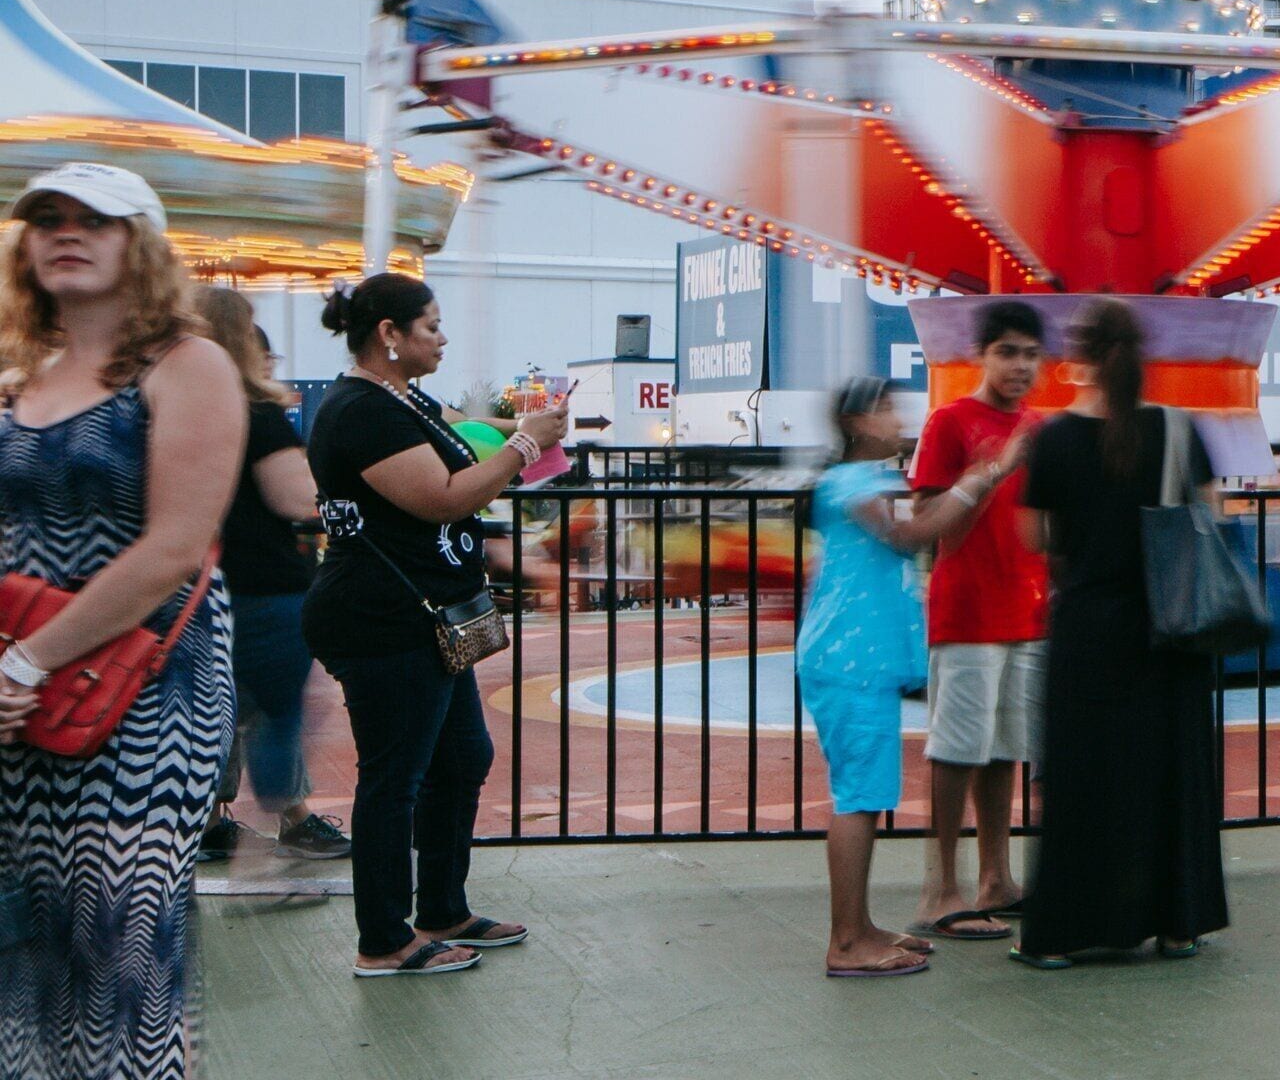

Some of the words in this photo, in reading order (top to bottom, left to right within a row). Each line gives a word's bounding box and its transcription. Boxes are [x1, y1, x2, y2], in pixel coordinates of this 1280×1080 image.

[684, 247, 727, 302] FUNNEL
[728, 241, 762, 296] CAKE
[716, 302, 726, 338] &
[689, 344, 723, 380] FRENCH
[724, 341, 751, 377] FRIES
